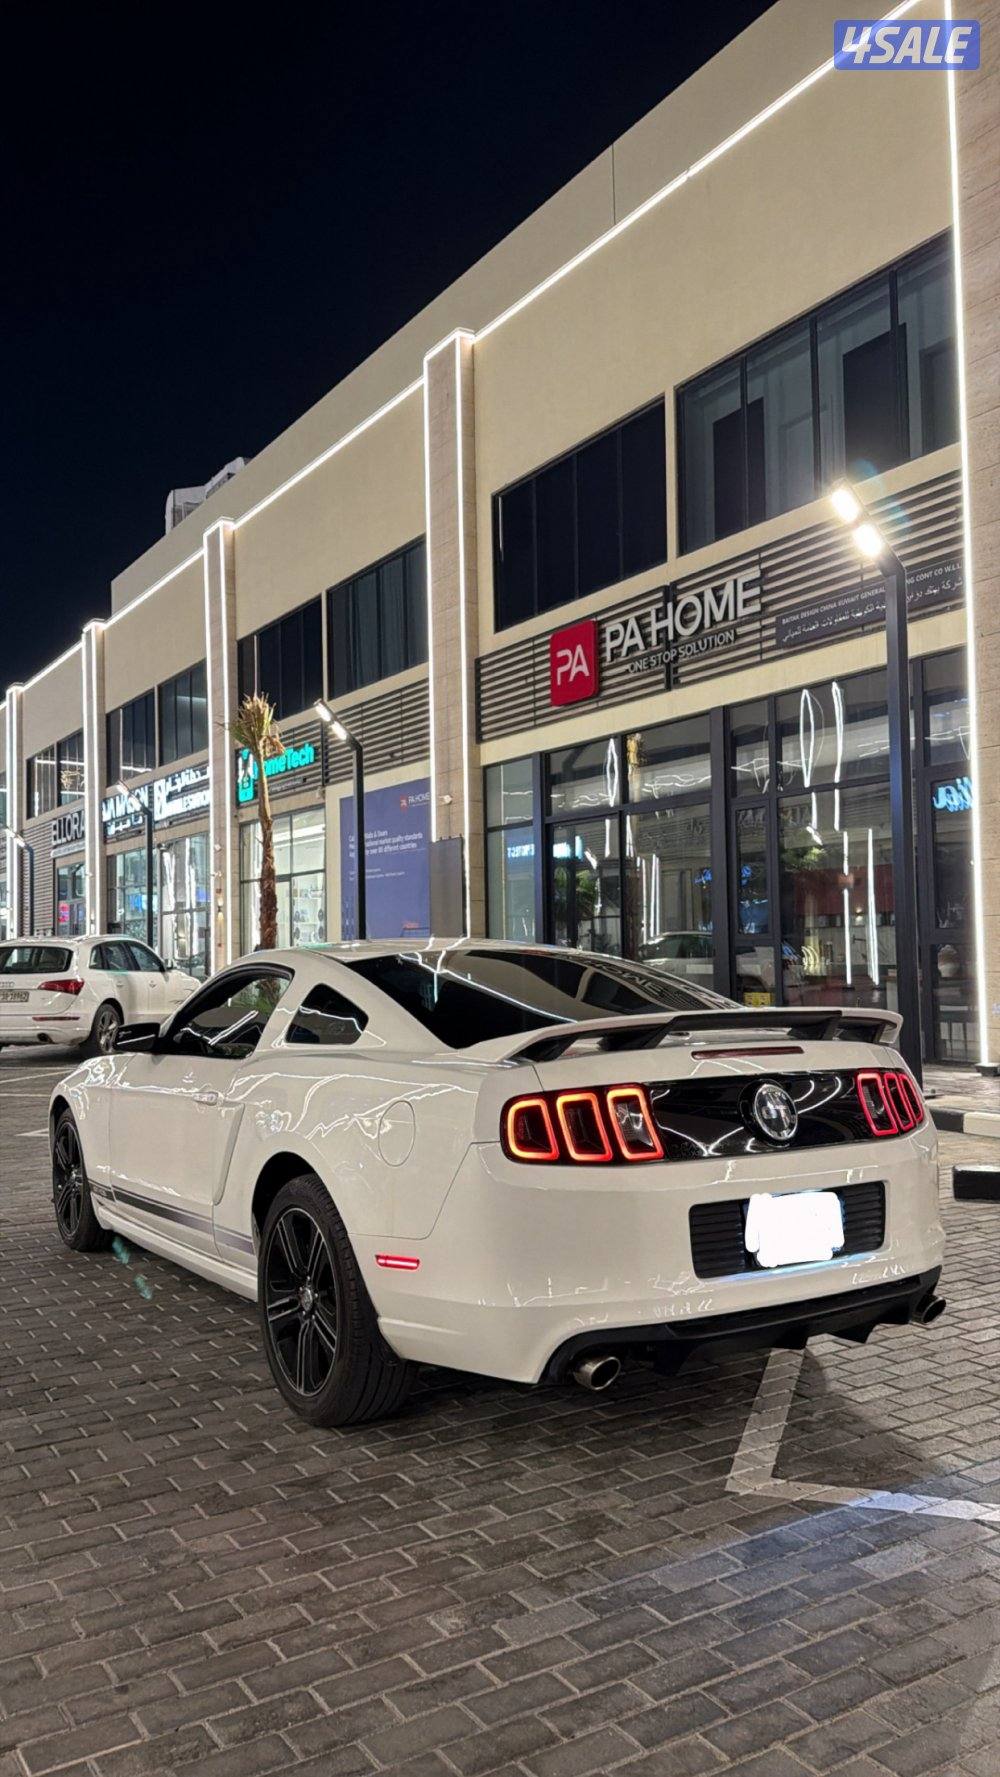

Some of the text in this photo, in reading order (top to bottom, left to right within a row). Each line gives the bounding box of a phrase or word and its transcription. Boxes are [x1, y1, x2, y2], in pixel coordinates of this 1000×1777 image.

[605, 565, 761, 663] PA HOME
[800, 608, 819, 620] DESIGN
[820, 602, 837, 613] CHINA
[838, 594, 860, 608] KUWAIT
[860, 587, 886, 600] GENERAL
[916, 571, 933, 584] CONT
[934, 567, 943, 577] CO
[556, 644, 589, 686] PA
[628, 629, 735, 674] ONE STOP SOLUTION
